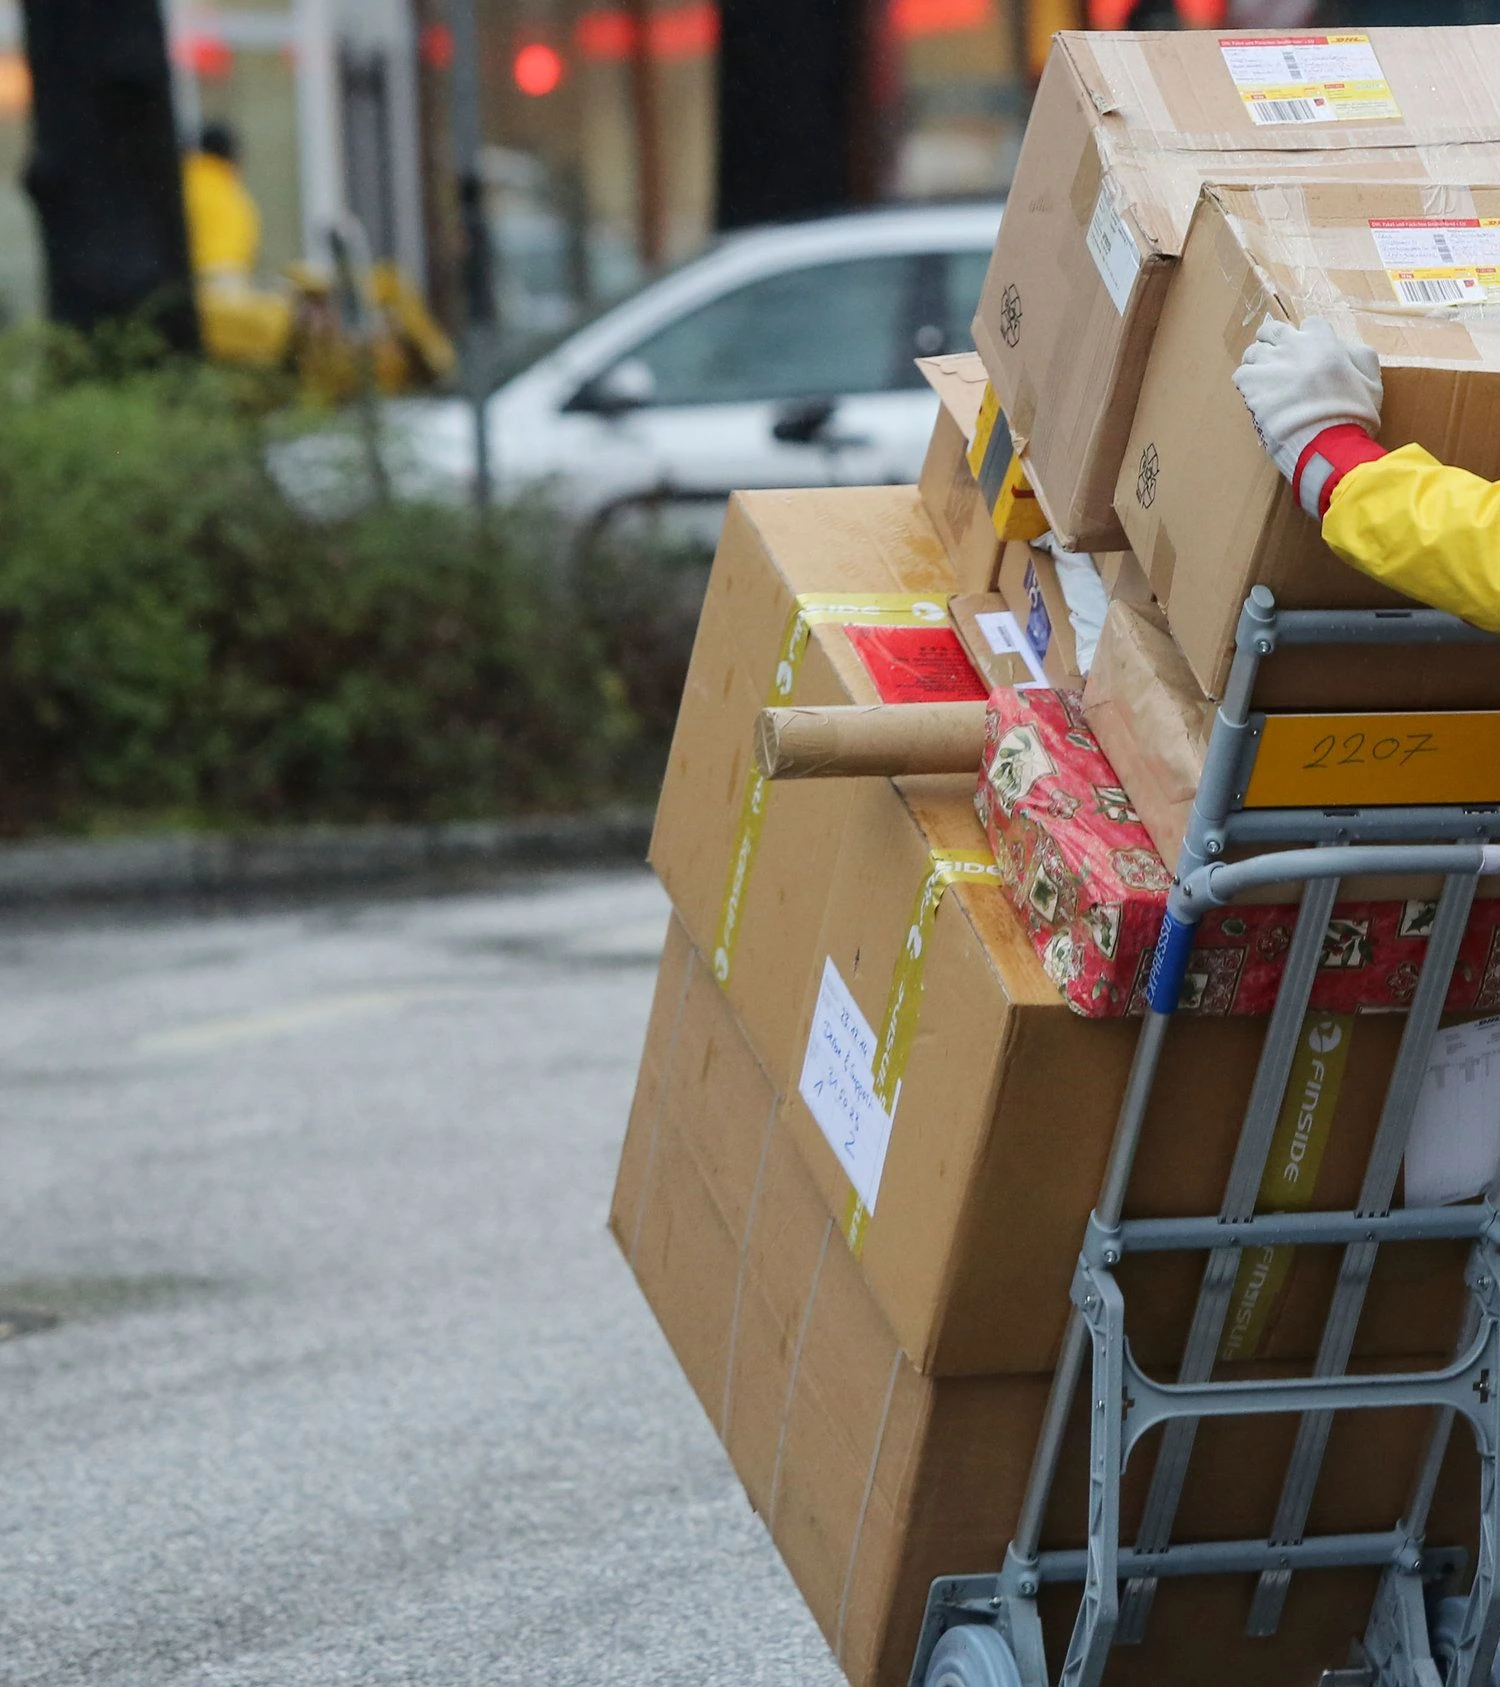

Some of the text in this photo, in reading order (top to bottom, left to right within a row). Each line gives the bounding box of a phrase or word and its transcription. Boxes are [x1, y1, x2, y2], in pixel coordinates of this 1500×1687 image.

[1301, 732, 1438, 769] 2207
[1145, 914, 1172, 1006] EXPRESSO
[1283, 1058, 1326, 1184] FINSIDE
